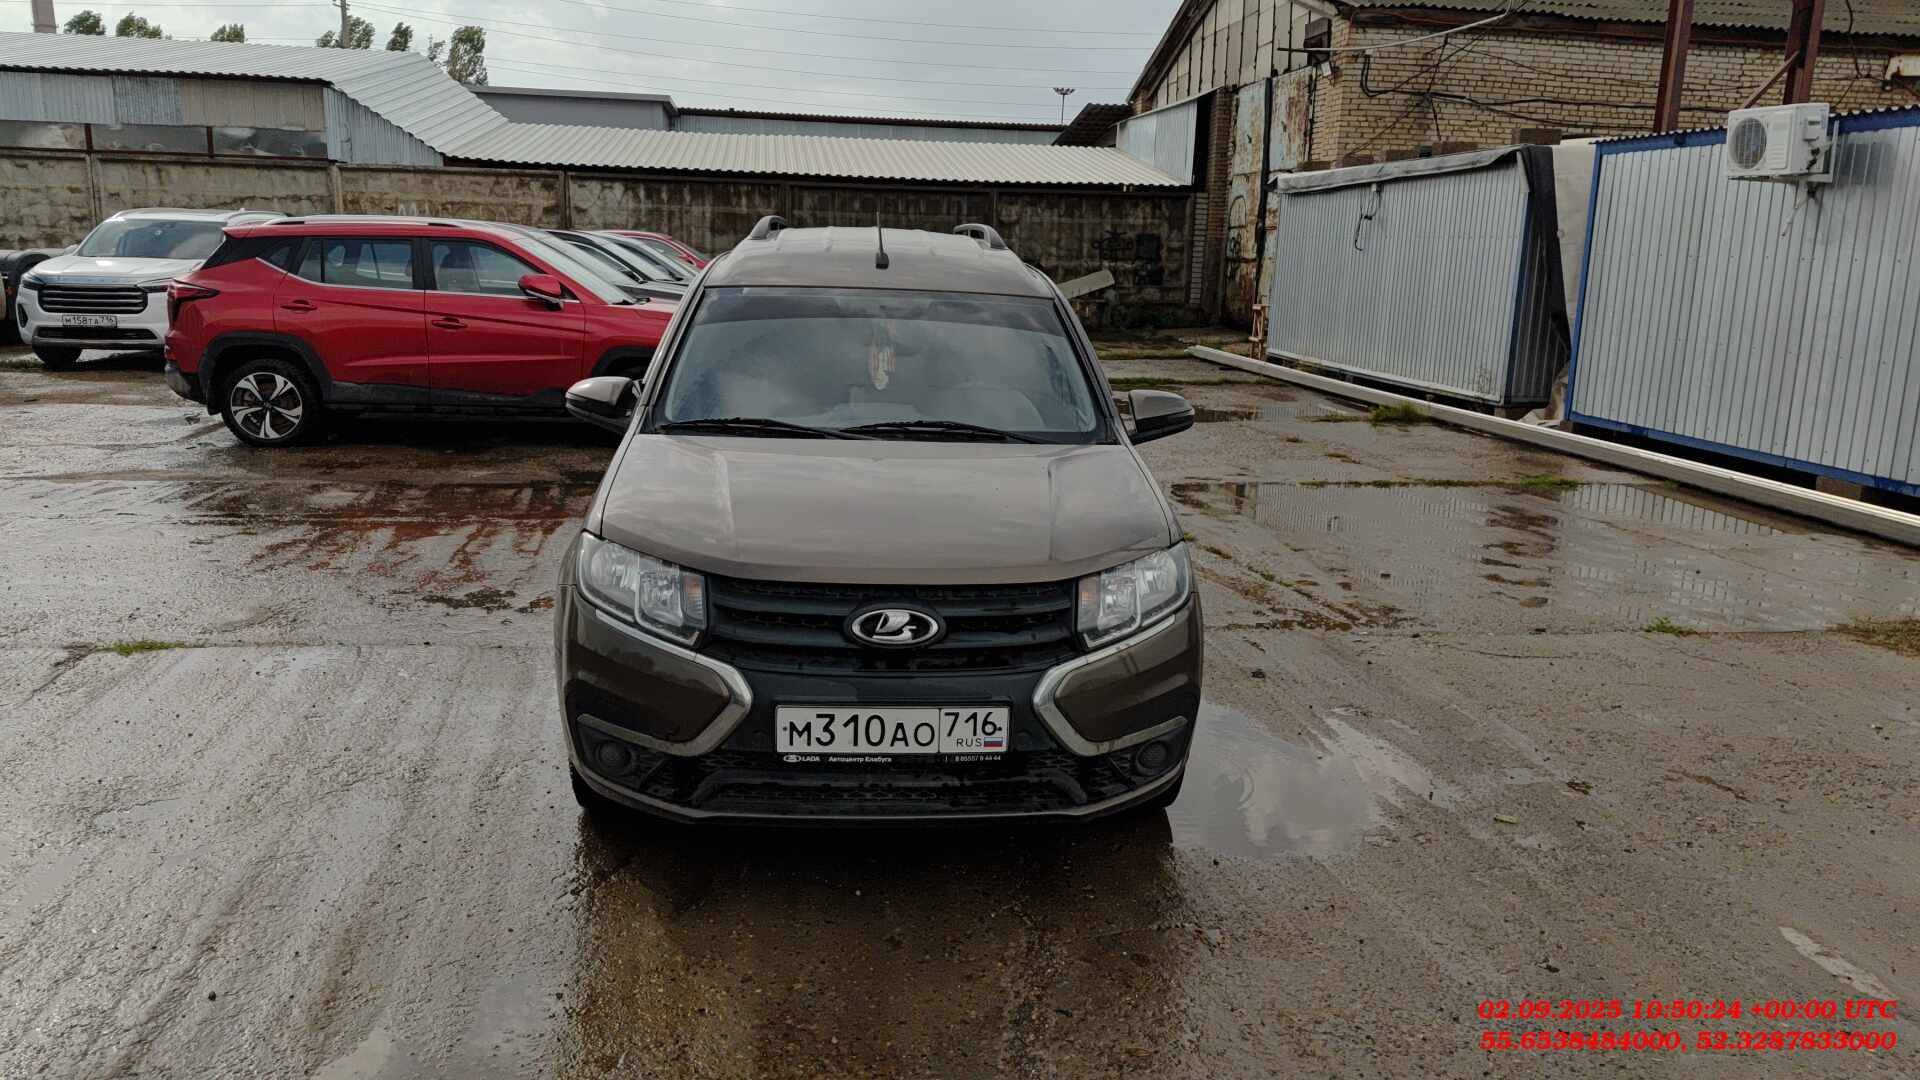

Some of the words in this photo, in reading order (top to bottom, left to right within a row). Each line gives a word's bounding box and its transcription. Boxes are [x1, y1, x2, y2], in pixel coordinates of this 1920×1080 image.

[789, 713, 936, 748] М310АО
[944, 711, 997, 737] 716
[956, 737, 982, 748] RUS
